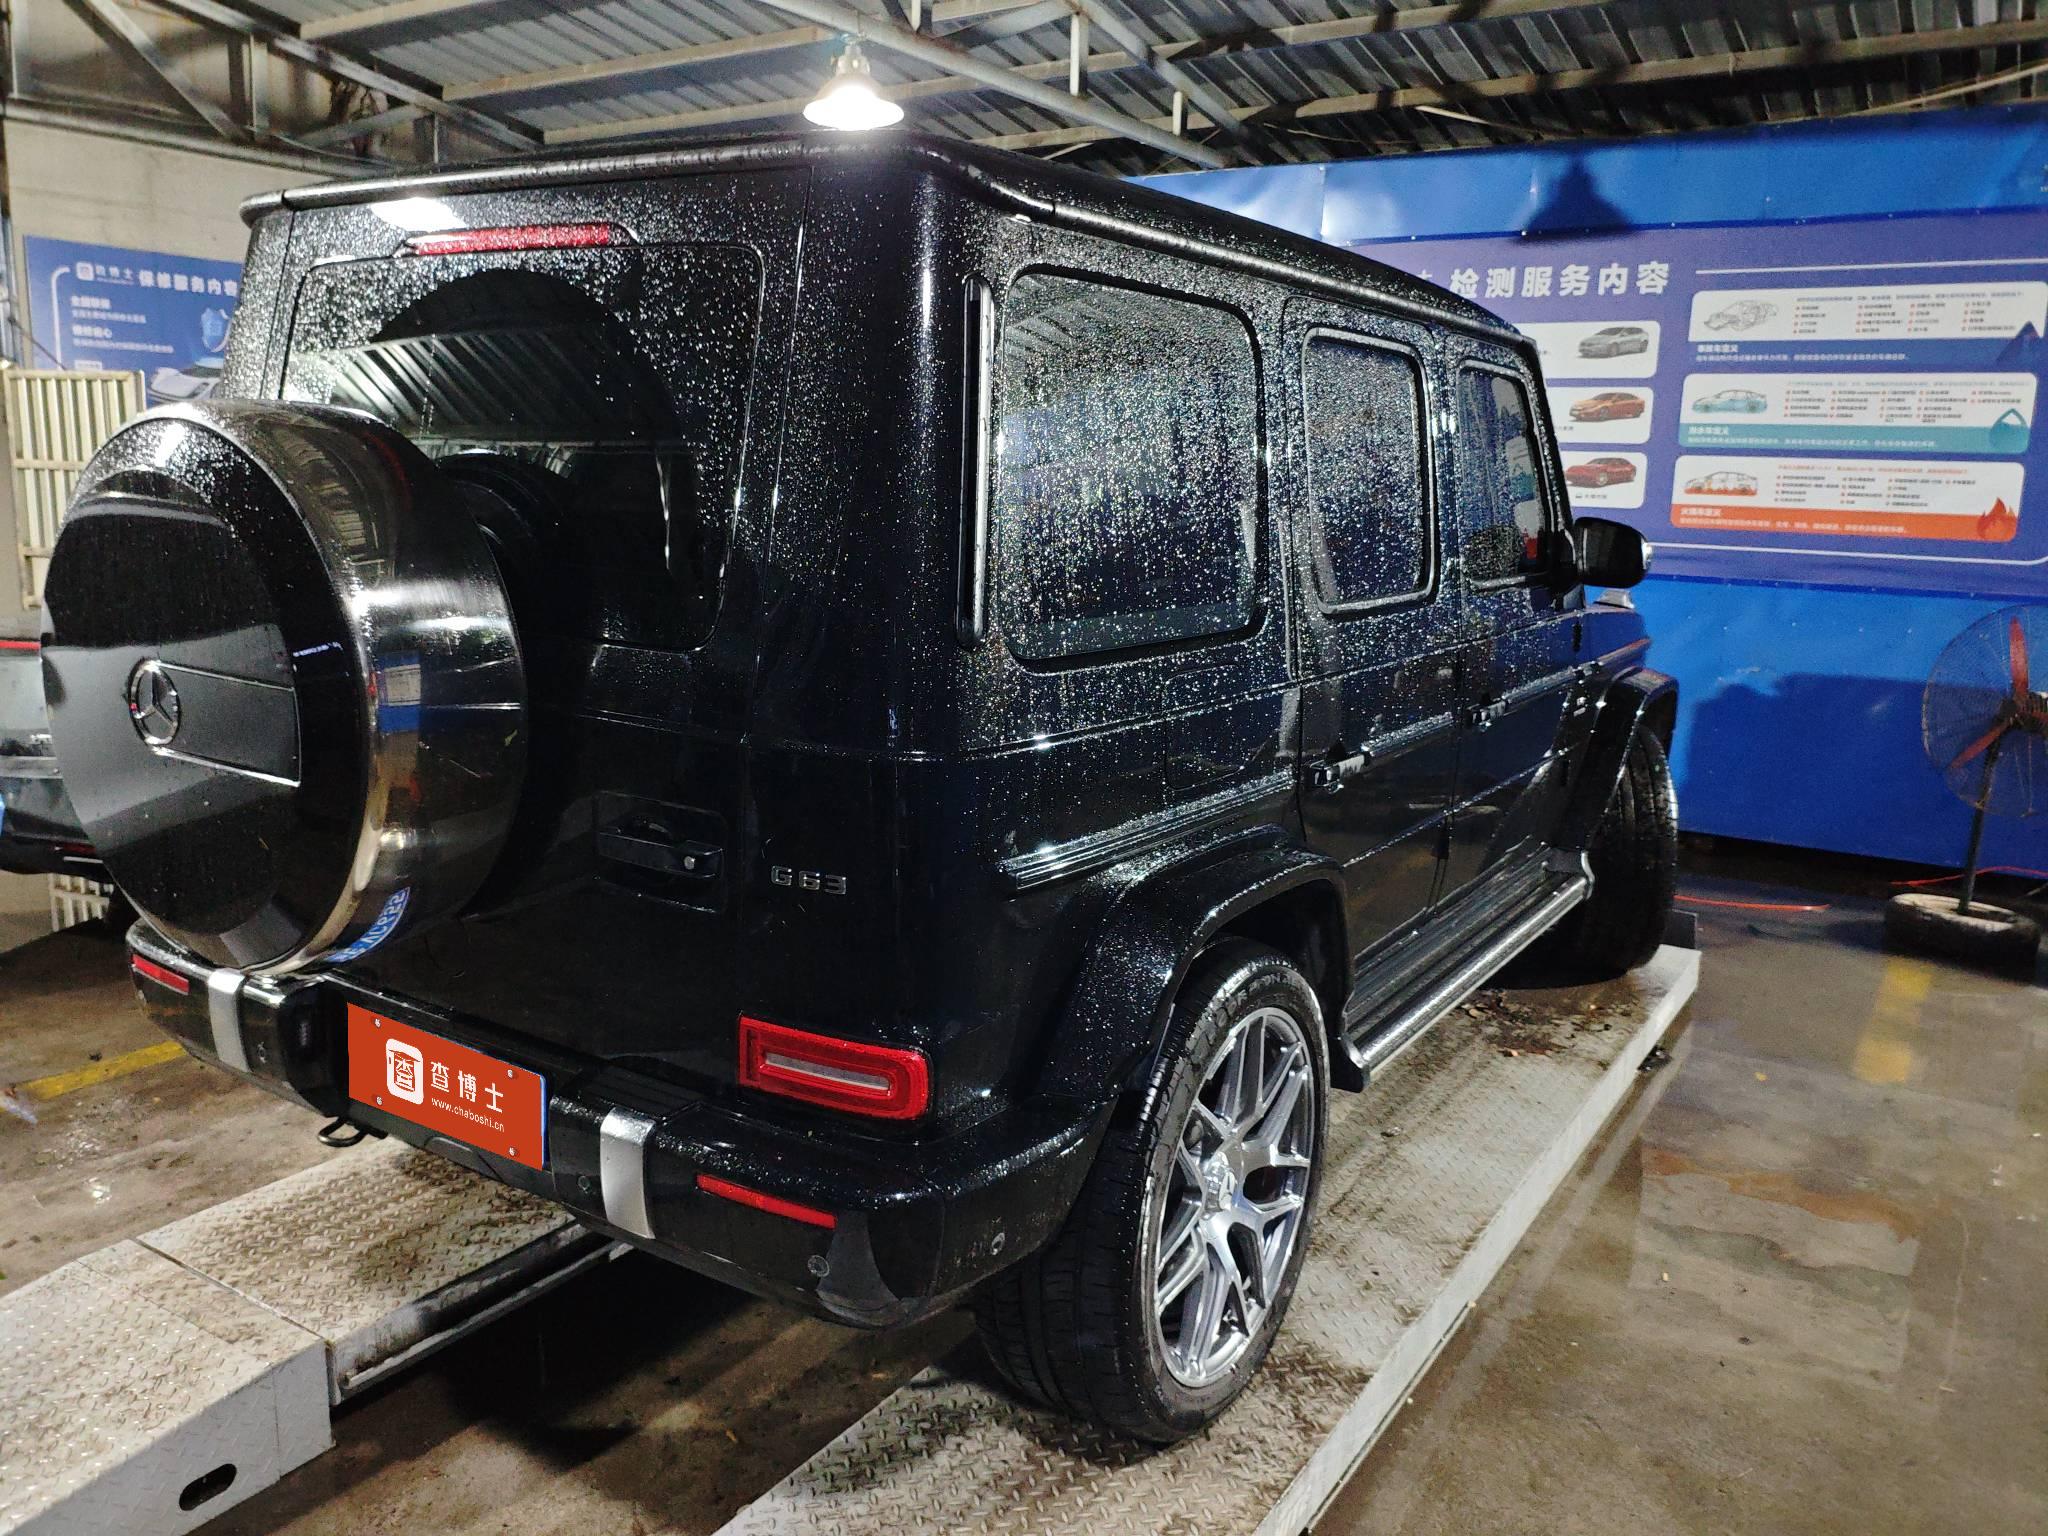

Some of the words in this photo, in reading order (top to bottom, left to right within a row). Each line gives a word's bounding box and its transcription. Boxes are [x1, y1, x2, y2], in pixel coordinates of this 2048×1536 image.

[1450, 260, 1670, 298] 检测服务内容
[771, 865, 847, 895] G63
